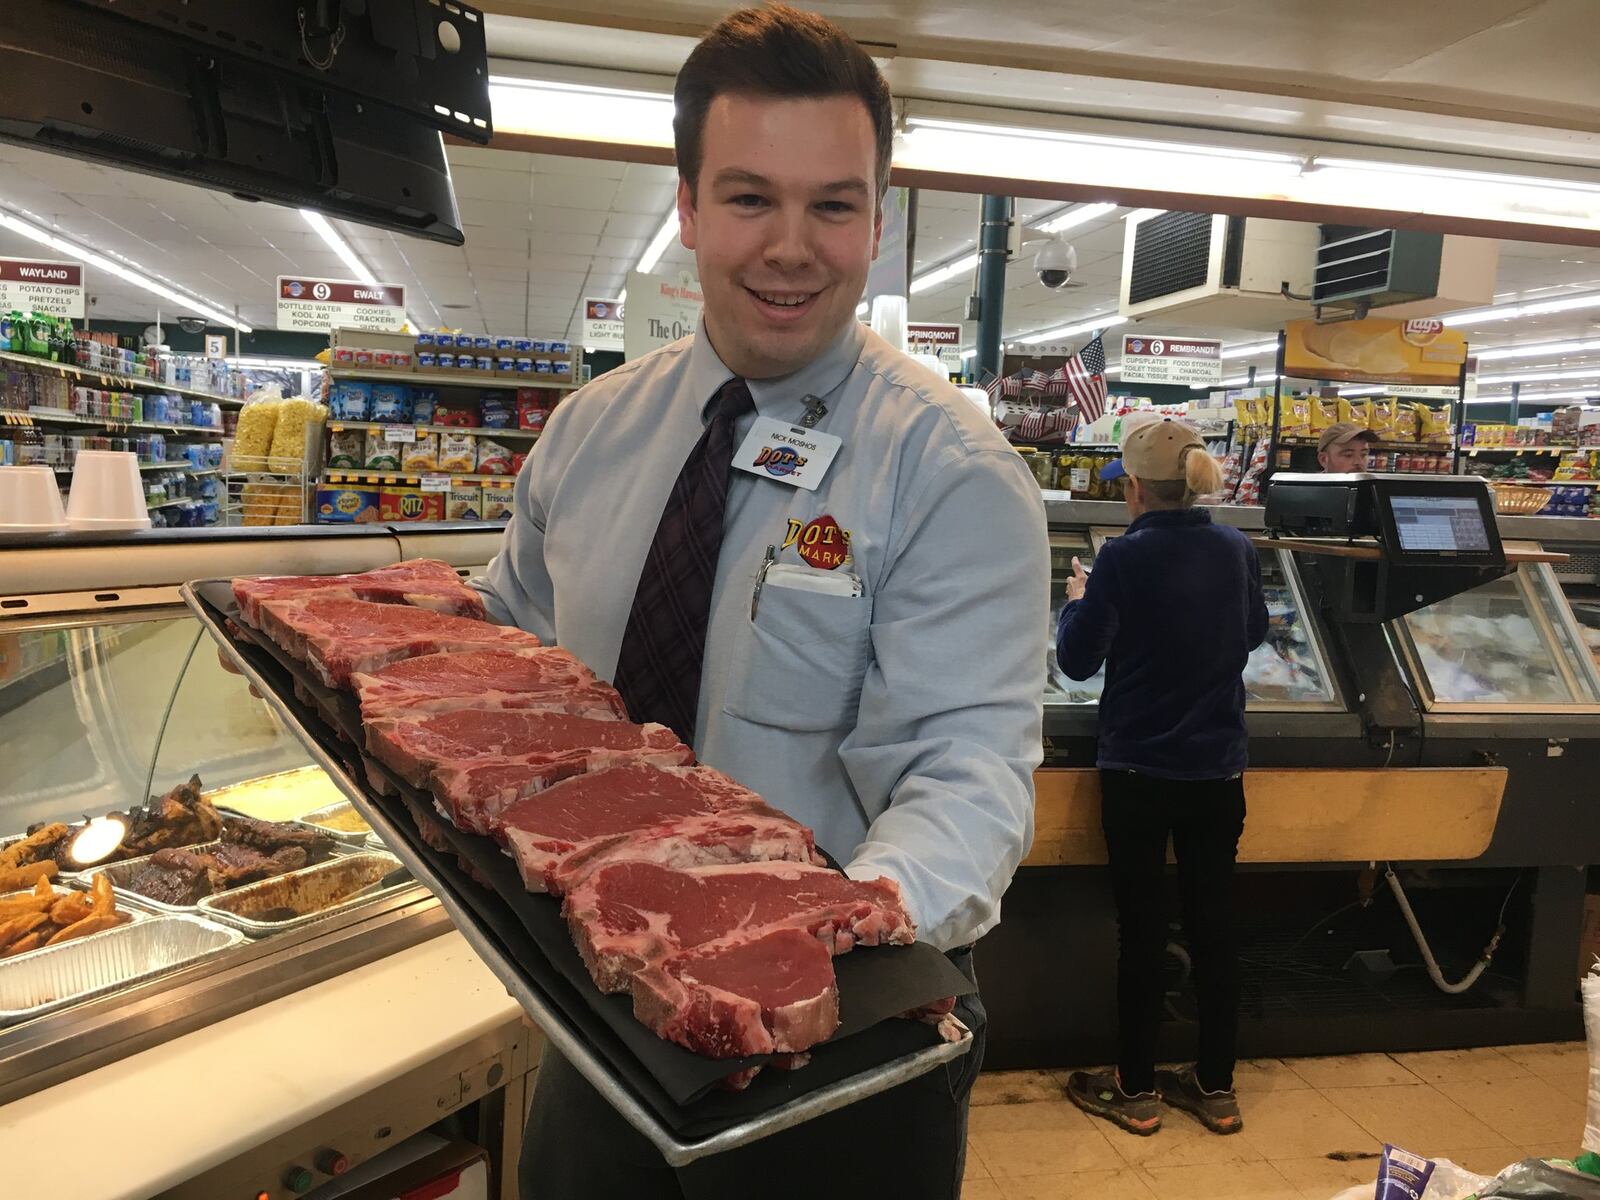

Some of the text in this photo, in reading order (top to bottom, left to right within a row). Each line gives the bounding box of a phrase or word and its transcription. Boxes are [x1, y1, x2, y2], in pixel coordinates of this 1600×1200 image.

[19, 267, 68, 280] WAYLAND
[19, 285, 80, 296] POTATO CHIPS
[316, 284, 327, 299] 9
[353, 289, 385, 300] EWALT
[28, 295, 72, 305] PRETZELS
[32, 304, 67, 313] SNACKS
[278, 303, 313, 311] BOTTLED
[356, 308, 391, 316] COOKIES
[292, 311, 314, 319] KOOL
[353, 315, 397, 324] CRACKERS
[292, 319, 331, 328] POPCORN
[648, 318, 670, 339] The
[210, 343, 220, 354] 5
[1153, 341, 1161, 354] 6
[1169, 344, 1215, 354] REMBRANDT
[1192, 361, 1221, 369] STORAGE
[1179, 368, 1213, 376] CHARCOAL
[771, 433, 817, 451] NICK MOSHOS
[450, 491, 479, 502] Triscuit
[400, 497, 423, 515] RITZ
